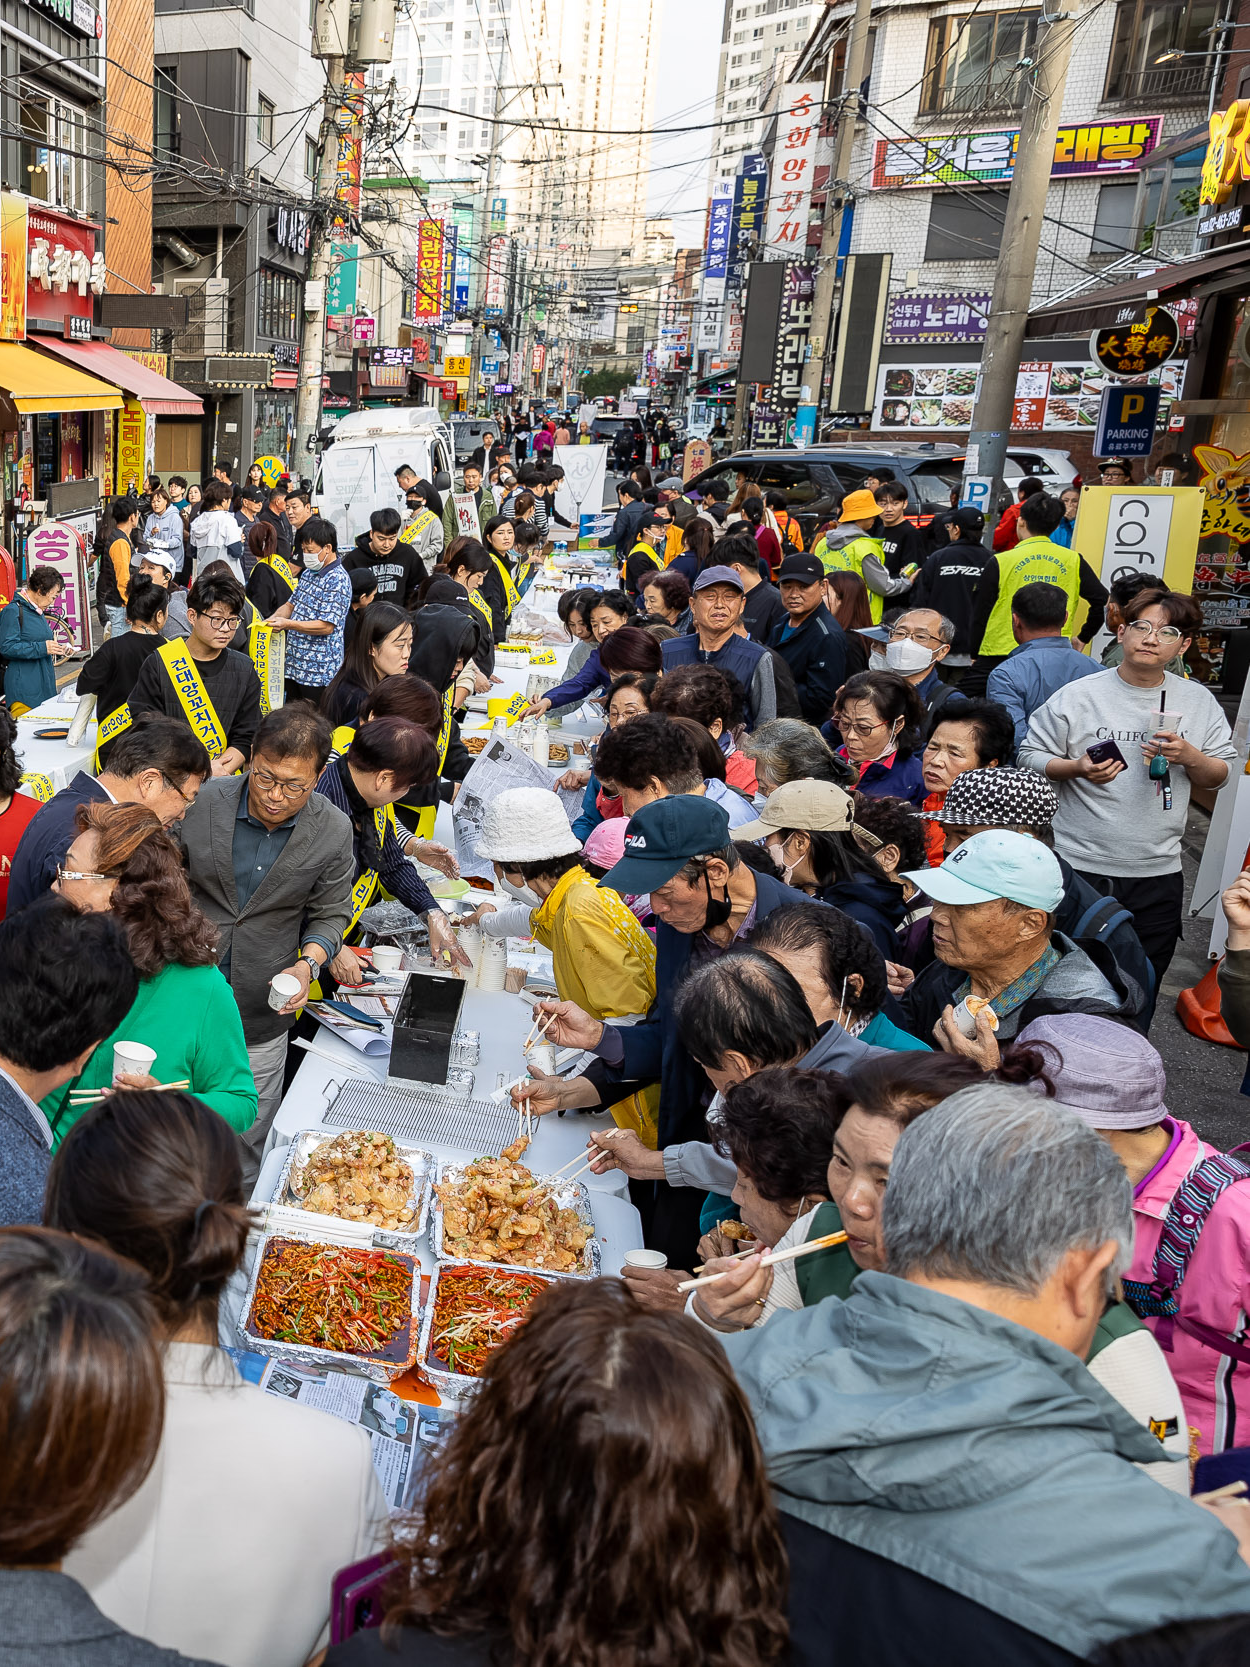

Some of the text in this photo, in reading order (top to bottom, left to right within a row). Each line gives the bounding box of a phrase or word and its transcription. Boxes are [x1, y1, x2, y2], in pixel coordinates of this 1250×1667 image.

[884, 123, 1151, 177] 즐거운 래방
[772, 93, 814, 244] 송화양꼬치
[788, 280, 816, 296] 신동
[1120, 394, 1145, 424] P
[1106, 428, 1149, 440] PARKING
[122, 404, 142, 495] 노래연습
[968, 482, 988, 502] P
[625, 835, 647, 848] FILA
